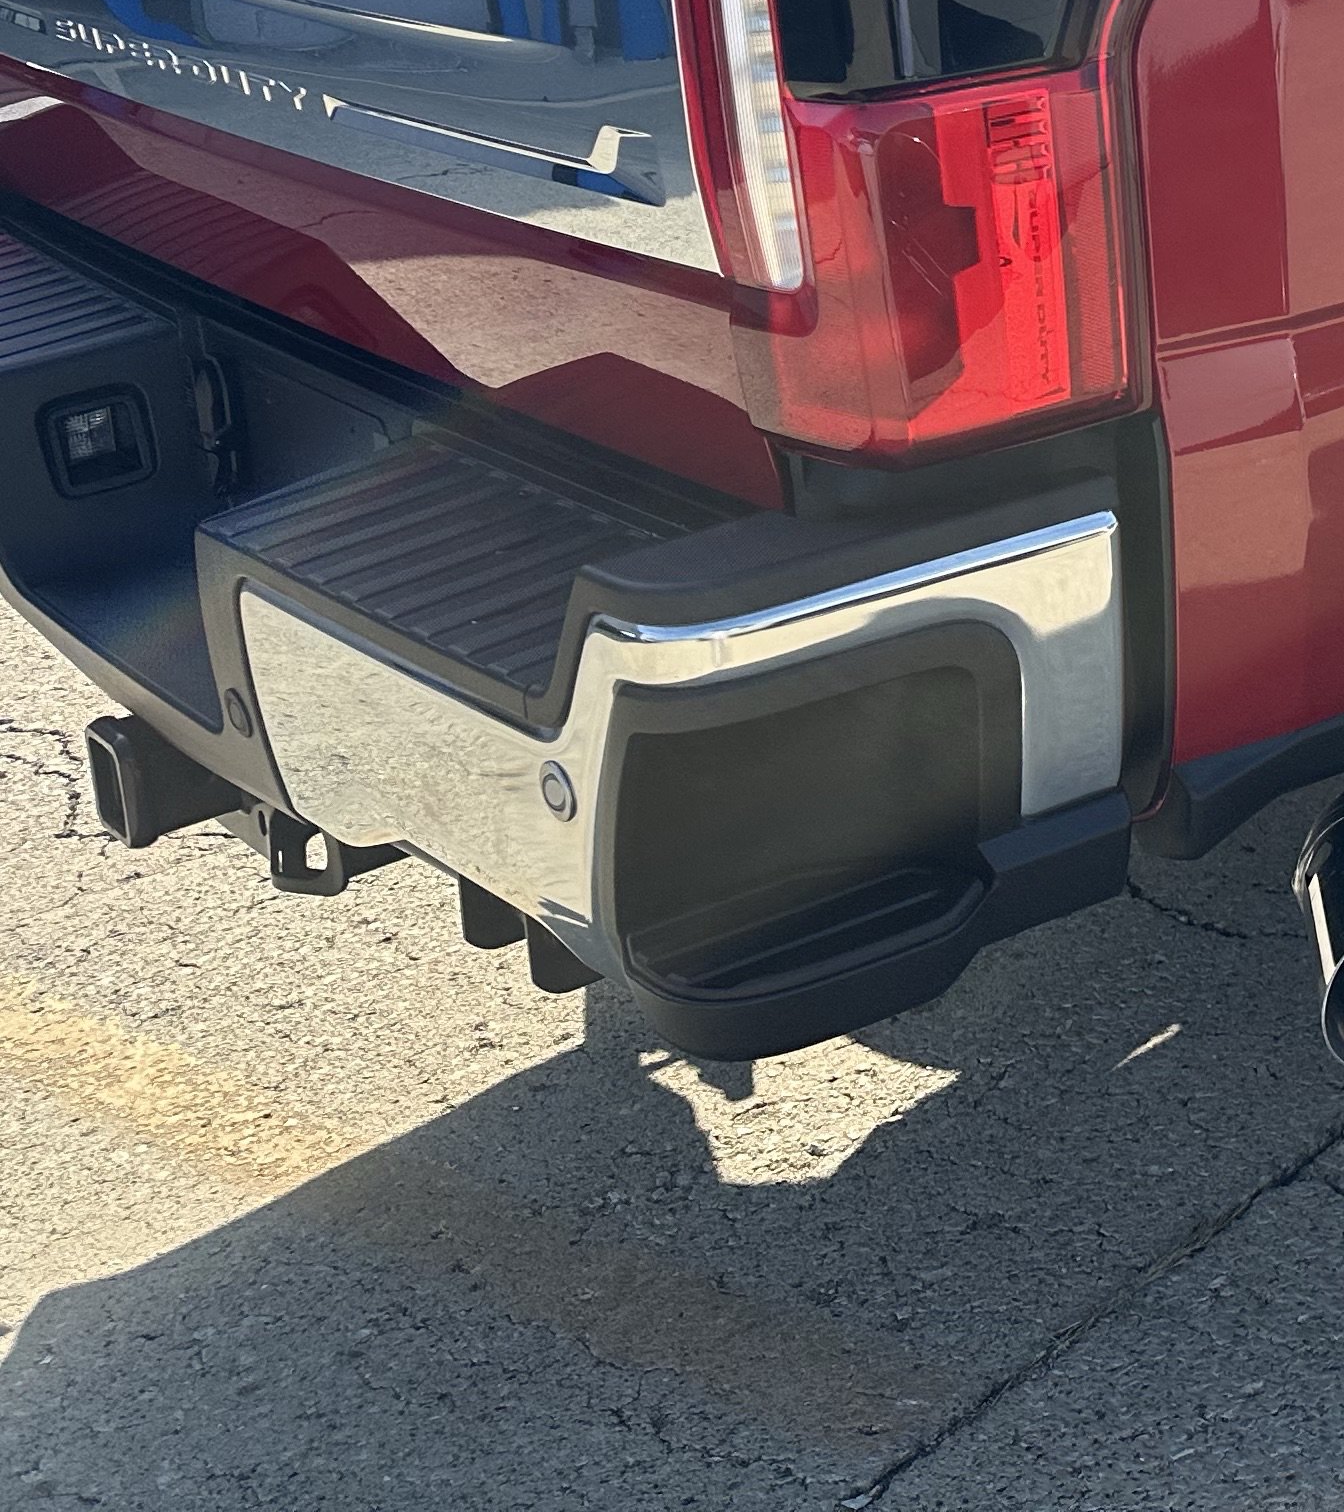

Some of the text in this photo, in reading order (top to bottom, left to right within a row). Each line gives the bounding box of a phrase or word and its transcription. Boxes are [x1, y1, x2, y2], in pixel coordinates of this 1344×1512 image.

[56, 19, 308, 111] SUPER DUTY
[1028, 189, 1044, 298] SUPER
